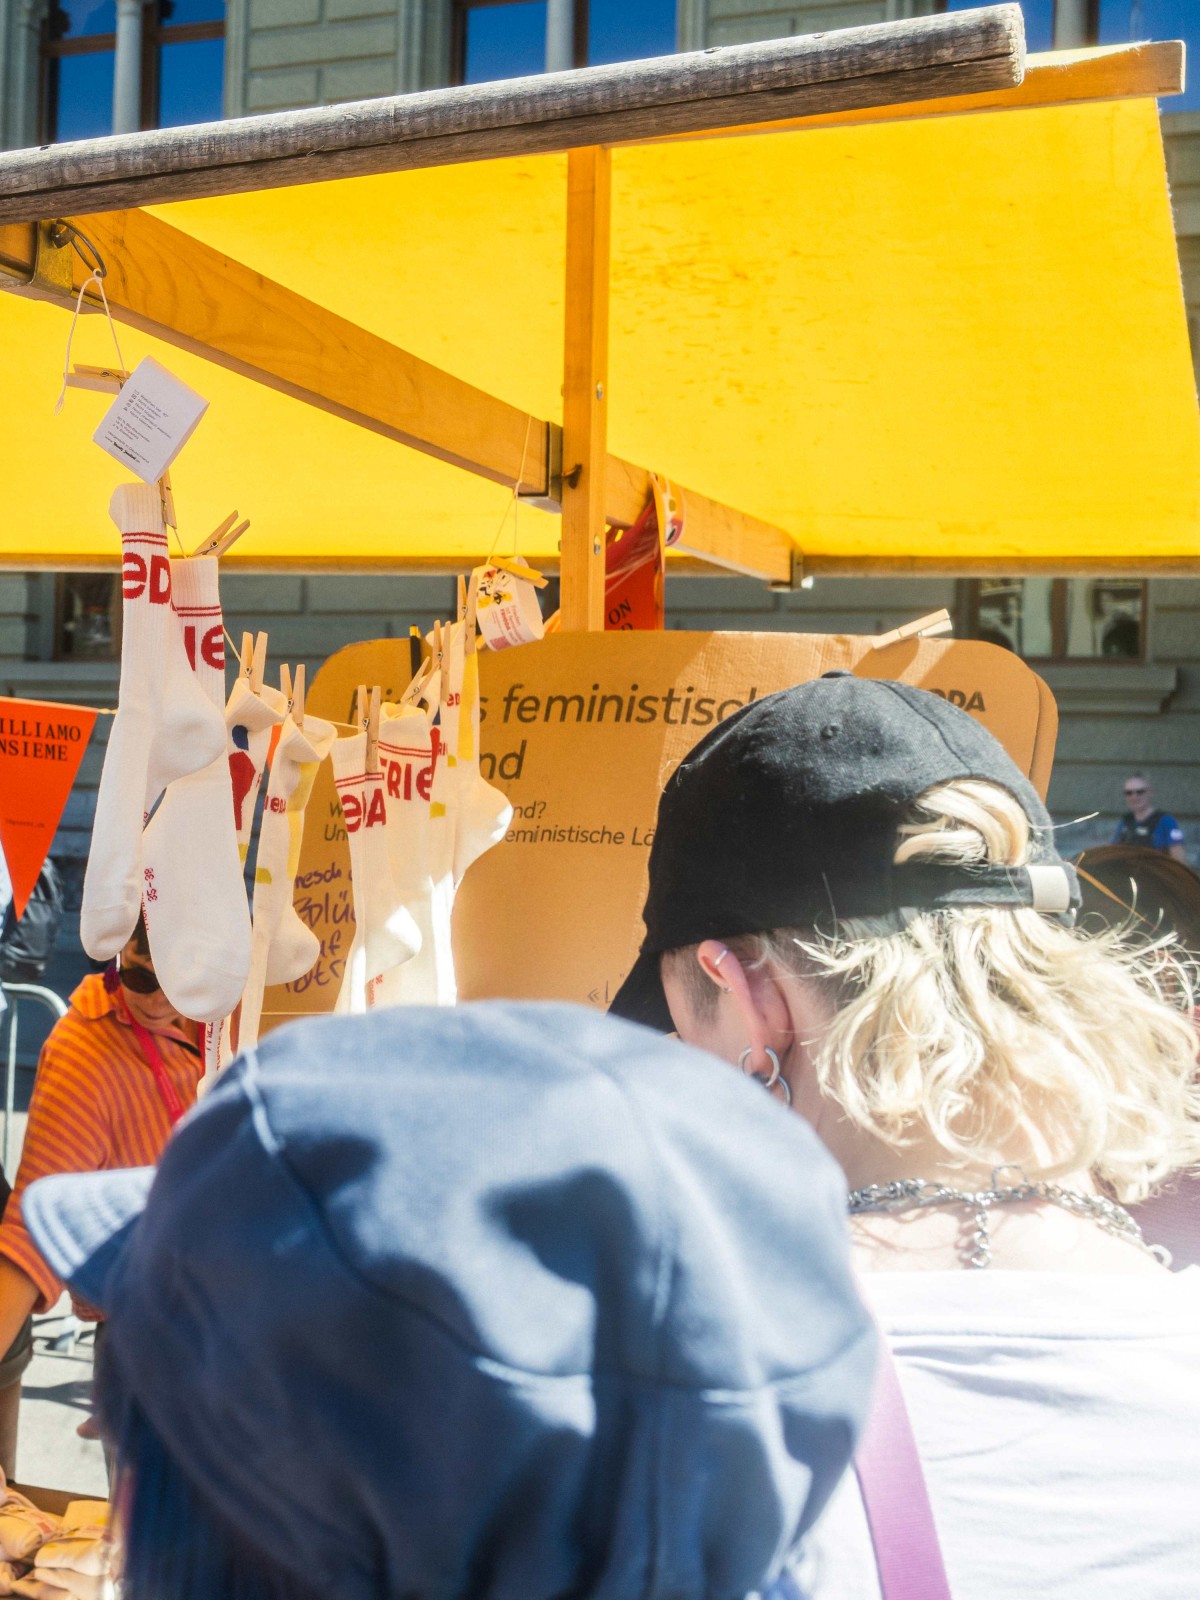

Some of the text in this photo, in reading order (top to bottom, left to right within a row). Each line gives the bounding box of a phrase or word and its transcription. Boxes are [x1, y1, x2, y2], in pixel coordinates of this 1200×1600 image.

[608, 599, 632, 626] ON
[502, 683, 757, 726] feministisc
[479, 739, 528, 780] nd
[513, 801, 546, 820] nd?
[504, 824, 625, 846] eministische
[631, 826, 656, 846] Lö
